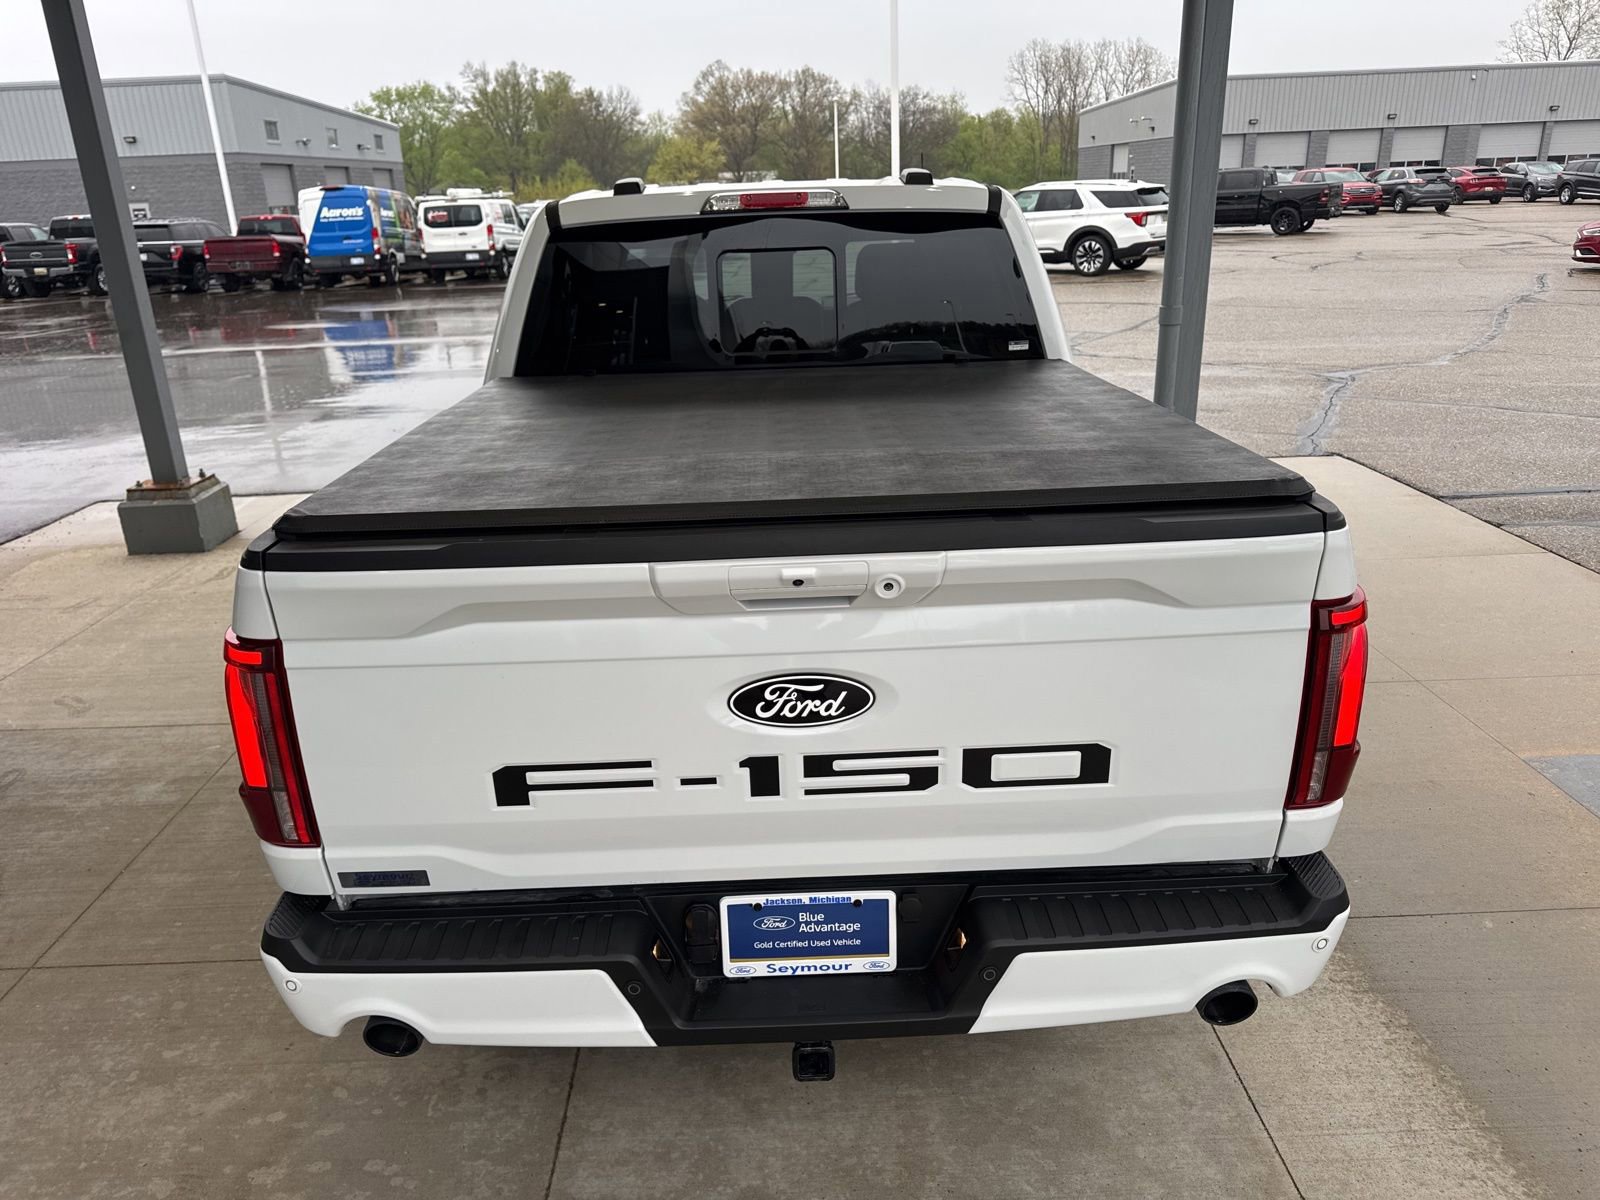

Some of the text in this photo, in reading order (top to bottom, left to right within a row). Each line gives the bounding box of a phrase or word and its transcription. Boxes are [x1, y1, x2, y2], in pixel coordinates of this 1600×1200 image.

[320, 206, 364, 217] Aaron's
[755, 683, 848, 719] Ford
[491, 742, 1112, 807] F-150
[809, 896, 852, 904] Michigan
[761, 912, 825, 929] Ford Blue
[799, 922, 861, 933] Advantage
[754, 938, 861, 949] Gold Certified Used Vehicle
[767, 963, 852, 975] Seymour
